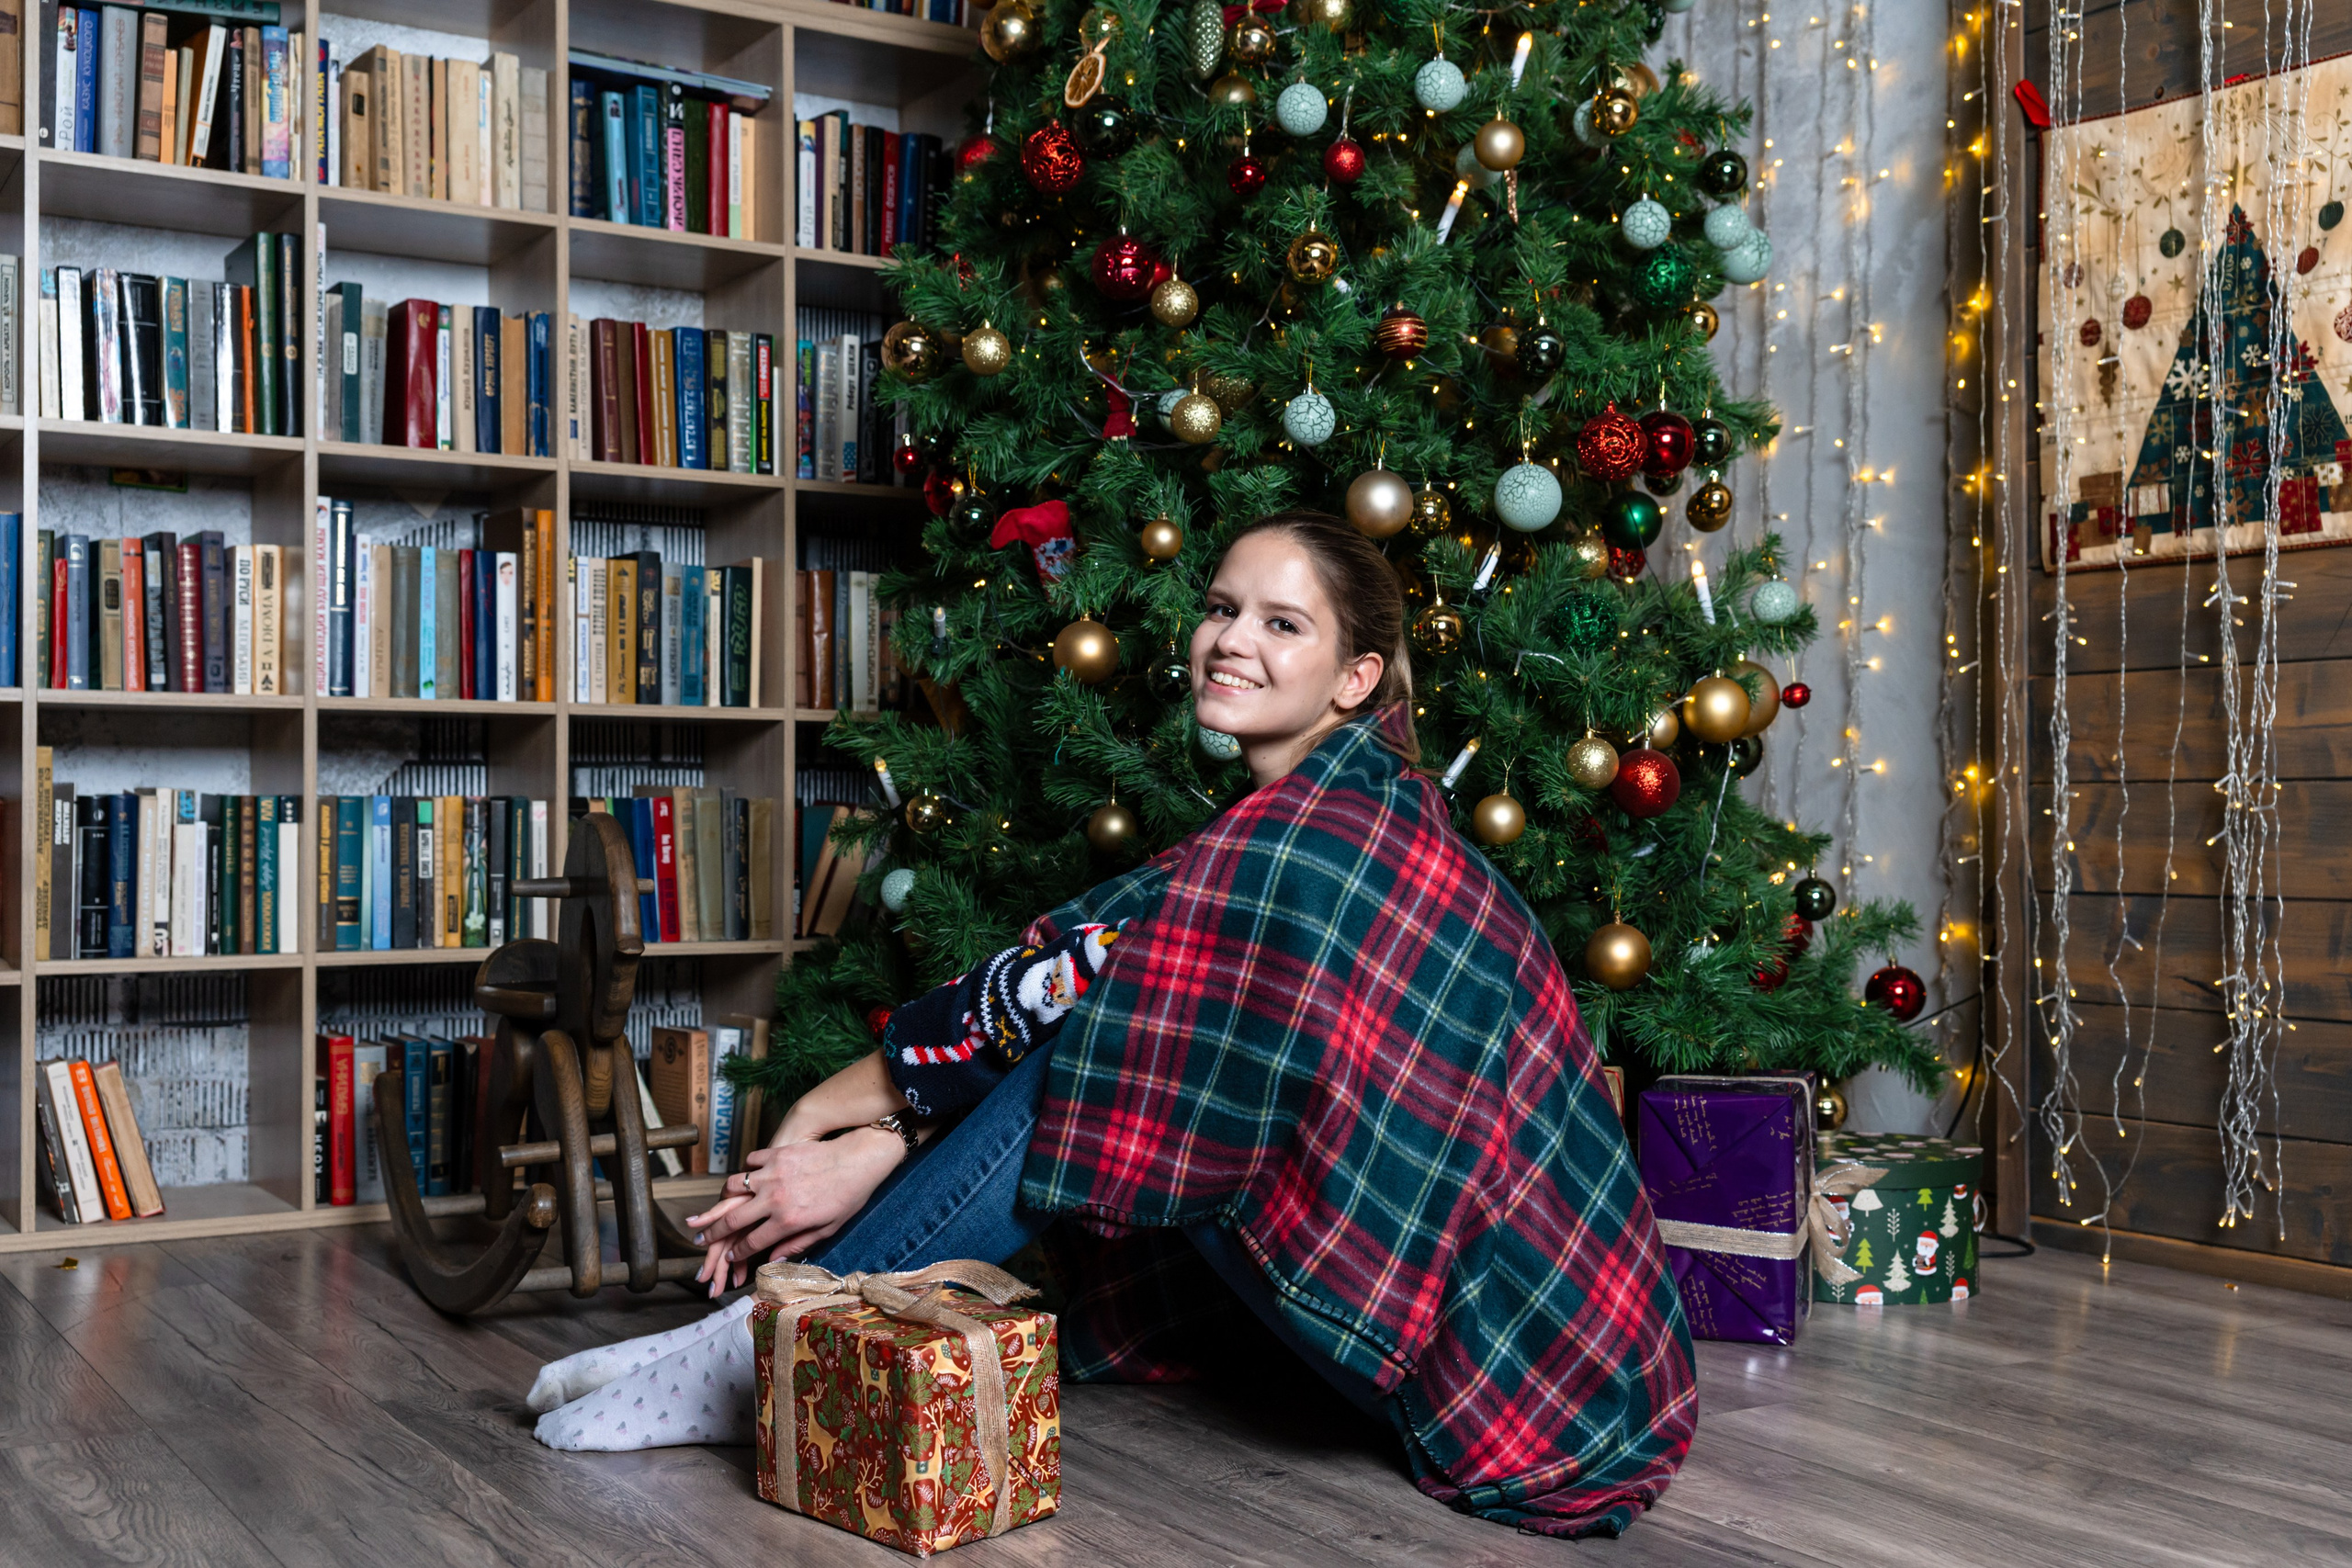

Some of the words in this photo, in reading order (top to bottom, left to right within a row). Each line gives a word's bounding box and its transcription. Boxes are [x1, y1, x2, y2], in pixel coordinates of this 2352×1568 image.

[83, 20, 94, 76] КУКОЦКОГО
[114, 17, 125, 67] ГОРБАЧЕВ
[82, 80, 91, 111] КАЗУС
[59, 106, 74, 142] Рой
[673, 176, 684, 227] ЖОРЖ
[569, 333, 577, 355] ПУТЬ
[759, 346, 768, 379] ФОСТЕР
[569, 358, 578, 414] КАМЕНИСТЫЙ
[239, 558, 250, 575] ПО
[239, 577, 250, 606] РУСИ
[262, 594, 273, 643] ДЮМА
[335, 1057, 348, 1115] БРАТИНА
